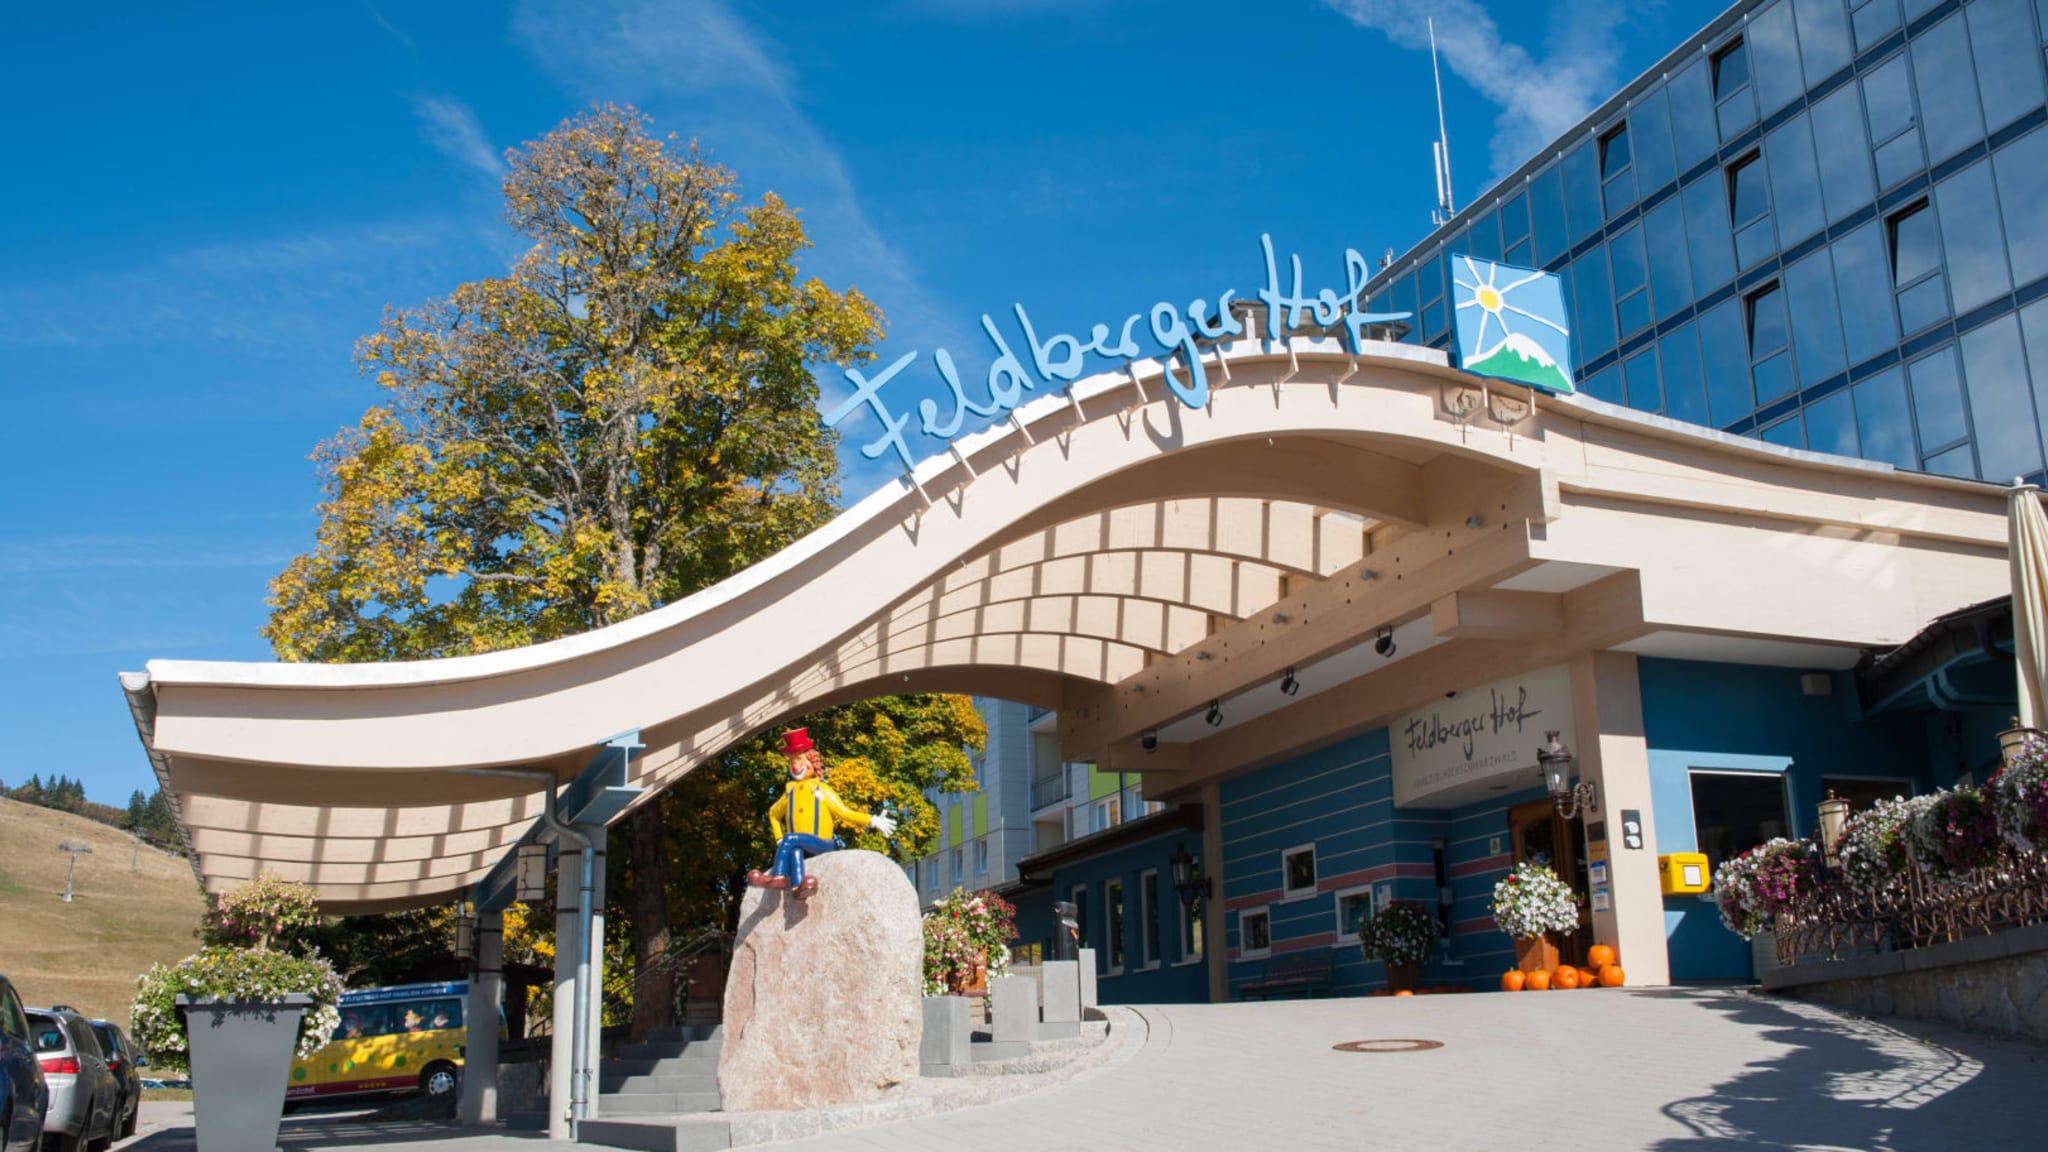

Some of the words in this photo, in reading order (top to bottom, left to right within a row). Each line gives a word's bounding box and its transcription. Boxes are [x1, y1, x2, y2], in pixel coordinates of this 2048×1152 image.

[821, 288, 1241, 473] Feldberger
[1259, 232, 1412, 357] Hof
[1404, 711, 1485, 761] Feldberger
[1489, 685, 1542, 735] Hof
